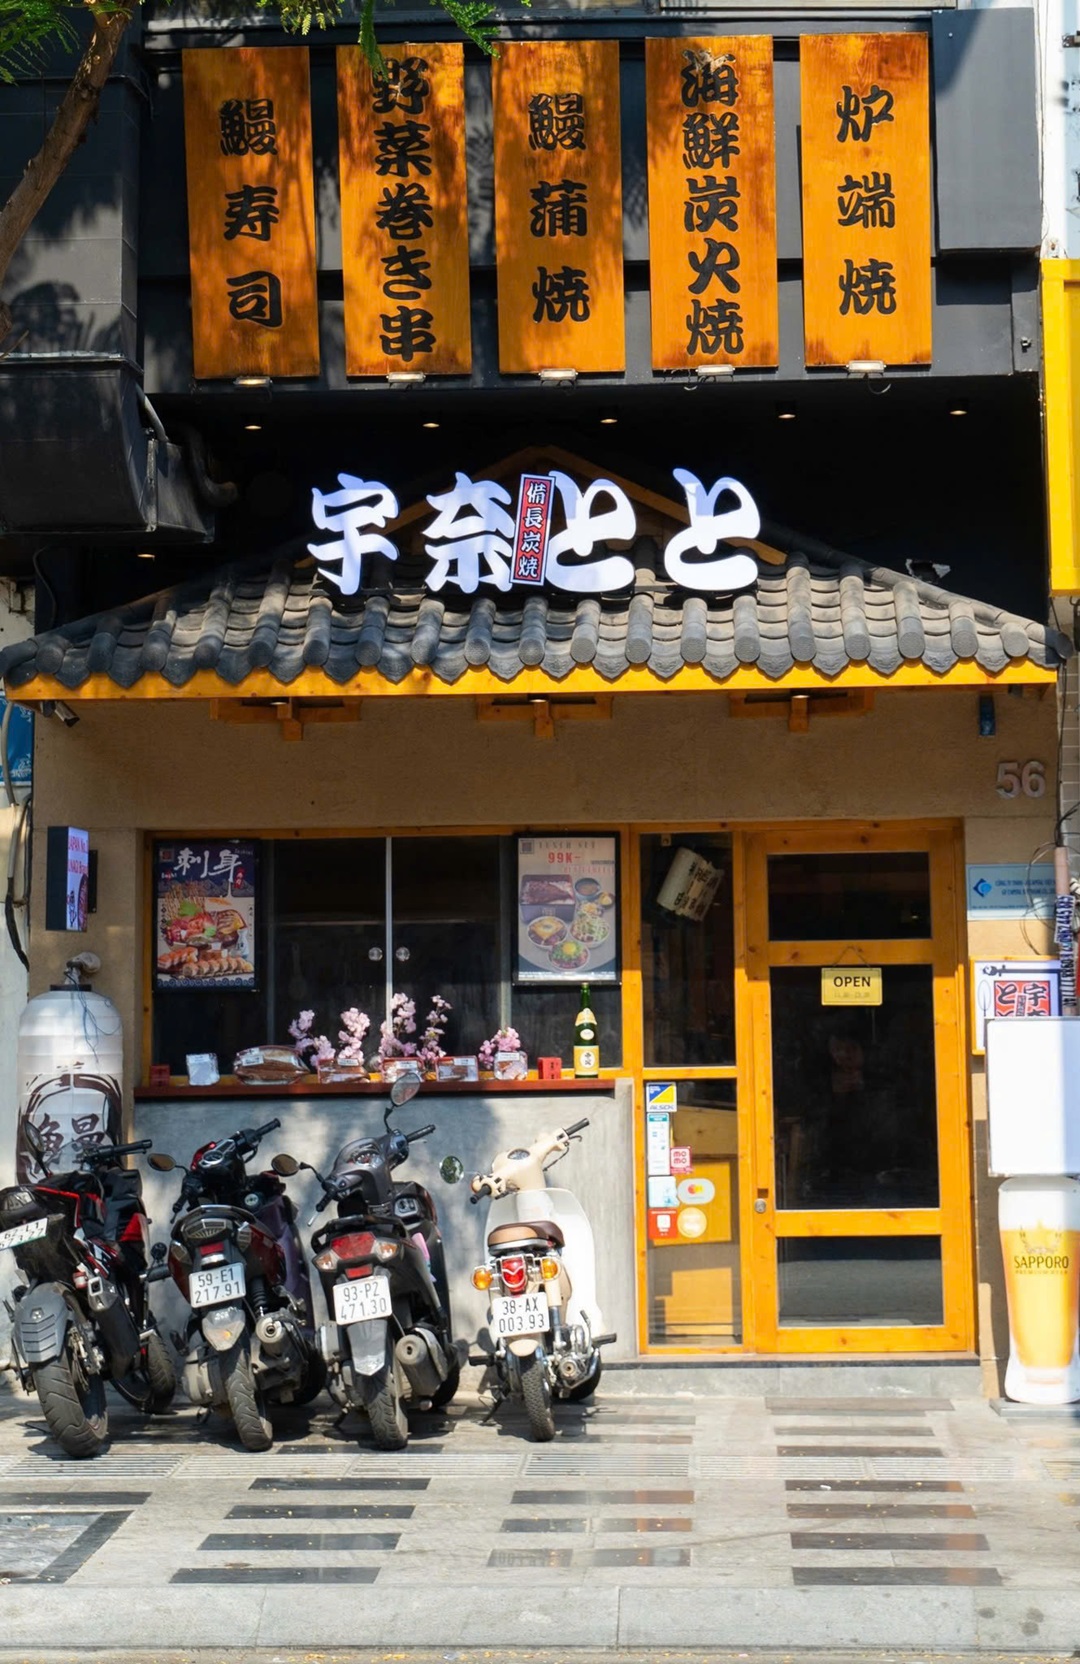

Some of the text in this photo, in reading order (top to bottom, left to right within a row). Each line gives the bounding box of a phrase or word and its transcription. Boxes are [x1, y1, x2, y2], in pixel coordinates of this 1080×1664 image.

[219, 98, 284, 328] 鰻寿司
[372, 56, 437, 363] 野菜巻き串
[528, 93, 591, 323] 鰻蒲焼
[680, 49, 745, 356] 海鮮炭火焼
[518, 482, 547, 579] 備長炭焼
[995, 760, 1046, 799] 56
[174, 847, 243, 883] 刺身
[833, 976, 871, 987] OPEN
[1013, 1255, 1070, 1269] SAPPORO
[197, 1268, 235, 1288] 59-E1
[194, 1281, 242, 1304] 217.91
[342, 1281, 380, 1302] 93-P2
[340, 1297, 387, 1320] 471.30
[502, 1296, 539, 1316] 38-AX
[498, 1313, 545, 1333] 003.93
